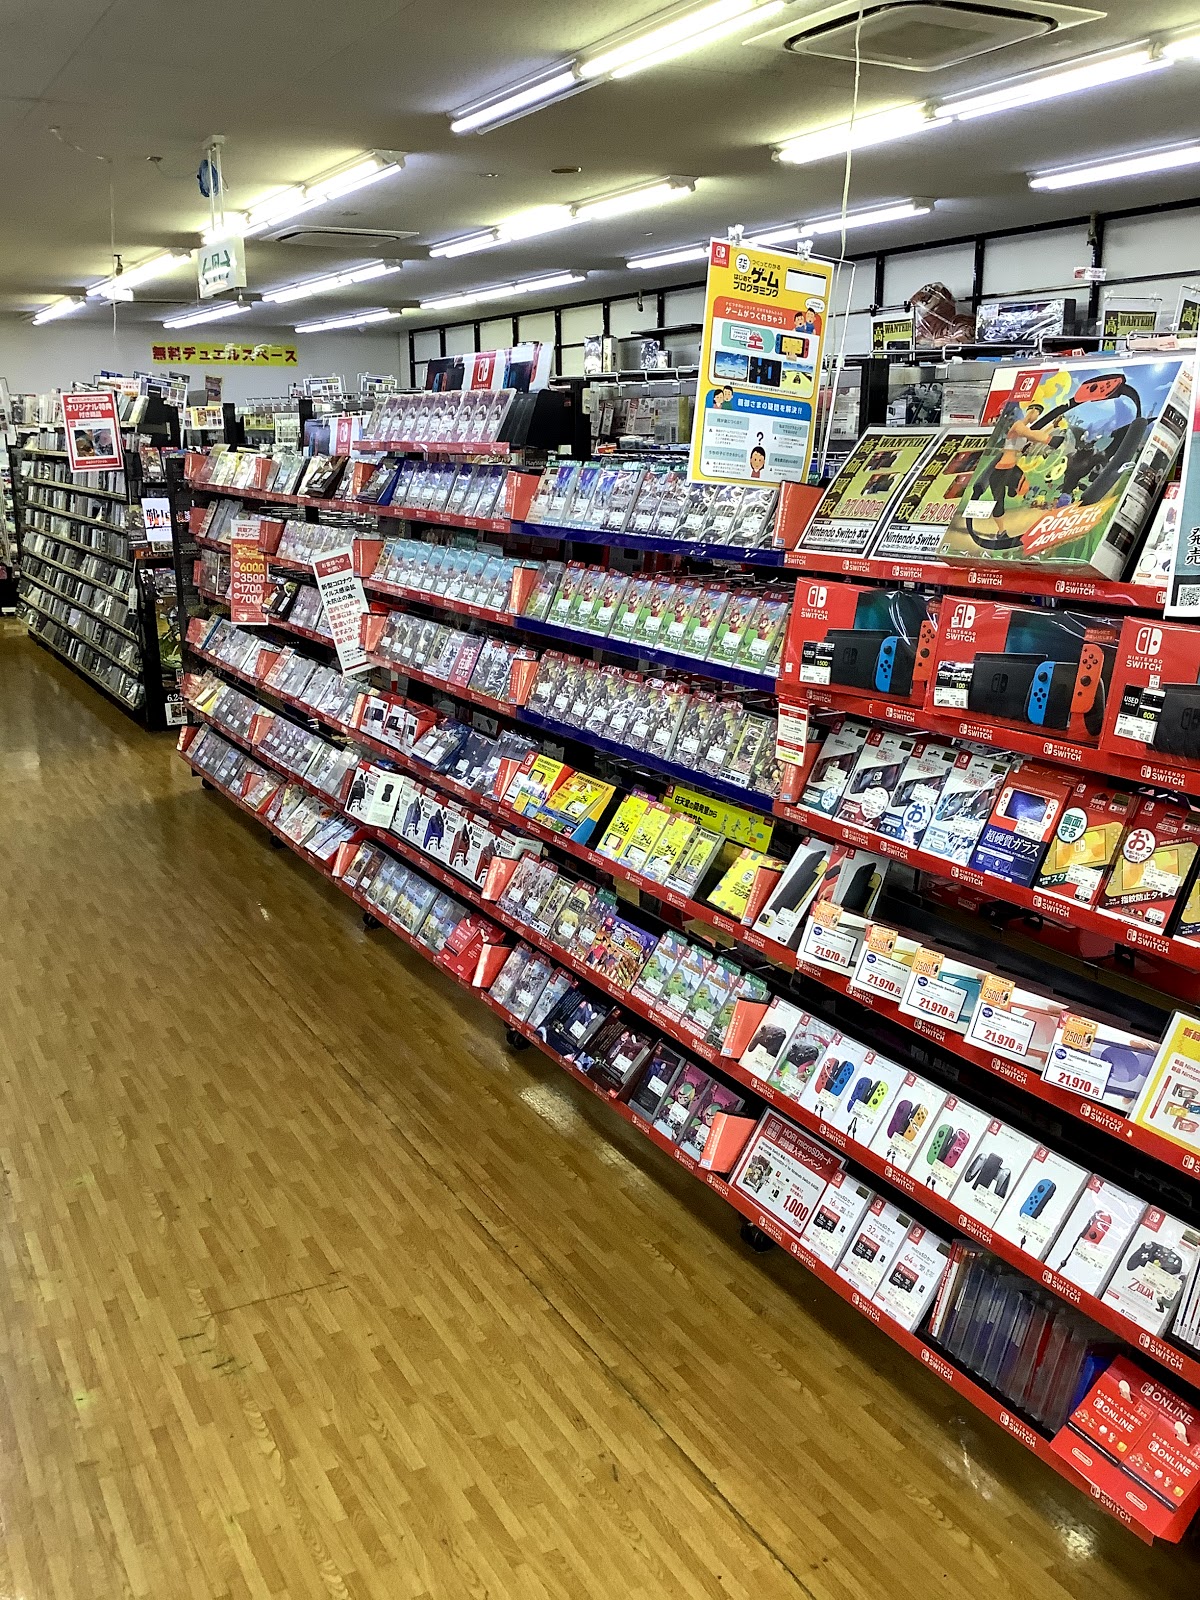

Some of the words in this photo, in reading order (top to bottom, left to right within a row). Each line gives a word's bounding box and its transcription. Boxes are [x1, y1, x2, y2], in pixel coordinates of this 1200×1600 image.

[752, 260, 781, 270] つくってわかる
[734, 274, 751, 283] はじめて
[751, 267, 779, 288] ゲーム
[733, 281, 778, 297] プログラミング
[725, 307, 786, 324] ゲームがつくれちゃう!
[1120, 315, 1153, 327] WANTED!
[152, 344, 297, 362] 無料デュエルスペース
[66, 403, 112, 411] オリジナル特典
[880, 438, 929, 448] WANTED!
[819, 438, 878, 516] 高価買取
[895, 439, 961, 520] 高価買取
[808, 526, 835, 538] Nintendo
[835, 528, 857, 539] Switch
[884, 532, 915, 544] Nintendo
[916, 534, 940, 546] Switch
[1026, 524, 1091, 550] Adventure
[240, 562, 265, 572] 6000
[849, 564, 870, 572] SWITCH
[900, 570, 922, 578] SWITCH
[240, 574, 265, 582] 3500
[321, 576, 352, 590] 新型コロナウ
[976, 577, 1002, 585] SWITCH
[241, 584, 262, 593] 1700
[324, 584, 356, 598] イルス感染拡
[1065, 586, 1094, 596] SWITCH
[326, 594, 355, 606] 大防止の為、
[801, 611, 828, 620] SWITCH
[946, 633, 976, 643] SWITCH
[1126, 660, 1163, 672] SWITCH
[1128, 654, 1163, 664] NINTENDO
[812, 695, 831, 703] SWITCH
[1124, 696, 1139, 704] USED
[893, 713, 914, 723] SWITCH
[967, 730, 992, 740] SWITCH
[1052, 749, 1082, 762] SWITCH
[1151, 773, 1184, 786] SWITCH
[1153, 768, 1185, 778] NINTENDO
[789, 812, 807, 823] SWITCH
[619, 822, 629, 832] ゲーム
[1060, 826, 1076, 837] 守る
[642, 834, 652, 845] ゲーム
[848, 834, 868, 846] SWITCH
[984, 829, 1040, 857] 超硬質ガラス
[666, 845, 676, 856] ゲーム
[887, 847, 908, 860] SWITCH
[959, 874, 983, 886] SWITCH
[1042, 898, 1070, 911] NINTENDO
[1042, 903, 1070, 917] SWITCH
[1148, 911, 1161, 920] Lite
[747, 934, 765, 948] SWITCH
[1137, 937, 1169, 953] SWITCH
[1138, 932, 1169, 946] NINTENDO
[802, 964, 821, 977] SWITCH
[852, 989, 873, 1006] SWITCH
[984, 987, 1000, 1001] 2500
[922, 1027, 945, 1042] SWITCH
[1065, 1030, 1082, 1044] 2500
[1000, 1066, 1026, 1085] SWITCH
[1001, 1062, 1028, 1078] NINTENDO
[756, 1084, 774, 1100] SWITCH
[1090, 1112, 1121, 1132] SWITCH
[1092, 1108, 1122, 1126] NINTENDO
[825, 1130, 846, 1148] SWITCH
[778, 1137, 822, 1170] 同時購入キャンペーン
[783, 1128, 797, 1142] HORI
[797, 1139, 832, 1165] microSDカード
[712, 1180, 728, 1197] SWITCH
[892, 1173, 914, 1192] SWITCH
[834, 1190, 855, 1206] microSDカード
[783, 1195, 808, 1221] 1,000
[764, 1223, 782, 1241] SWITCH
[873, 1218, 896, 1235] microSDカード
[968, 1221, 993, 1238] NINTENDO
[966, 1225, 992, 1244] SWITCH
[796, 1249, 816, 1269] SWITCH
[911, 1247, 936, 1264] microSDカード
[1052, 1276, 1081, 1297] NINTENDO
[1052, 1281, 1080, 1303] SWITCH
[1128, 1278, 1154, 1300] ZELDA
[858, 1300, 880, 1322] SWITCH
[1150, 1344, 1182, 1370] SWITCH
[1152, 1339, 1184, 1363] NINTENDO
[928, 1359, 952, 1381] SWITCH
[1152, 1392, 1194, 1425] ONLINE
[1102, 1405, 1135, 1432] ONLINE
[1008, 1422, 1036, 1448] SWITCH
[1010, 1418, 1037, 1441] NINTENDO
[1158, 1448, 1192, 1477] ONLINE
[1101, 1496, 1131, 1523] SWITCH
